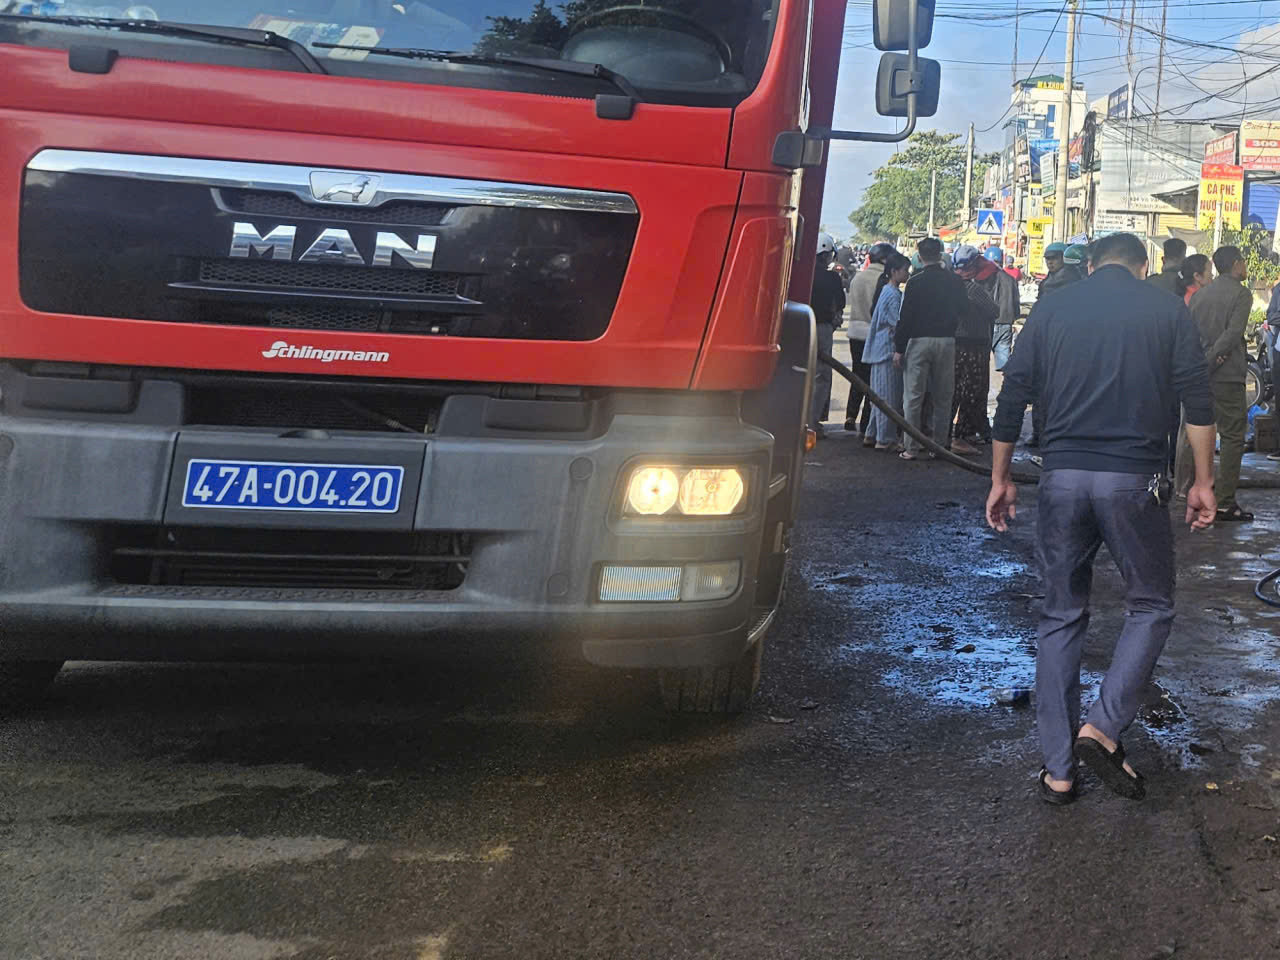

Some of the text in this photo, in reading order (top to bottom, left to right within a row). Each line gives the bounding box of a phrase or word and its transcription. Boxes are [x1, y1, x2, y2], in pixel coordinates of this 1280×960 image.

[229, 222, 437, 269] MAN
[262, 341, 389, 363] Schlingmann
[192, 465, 393, 507] 47A-004.20
